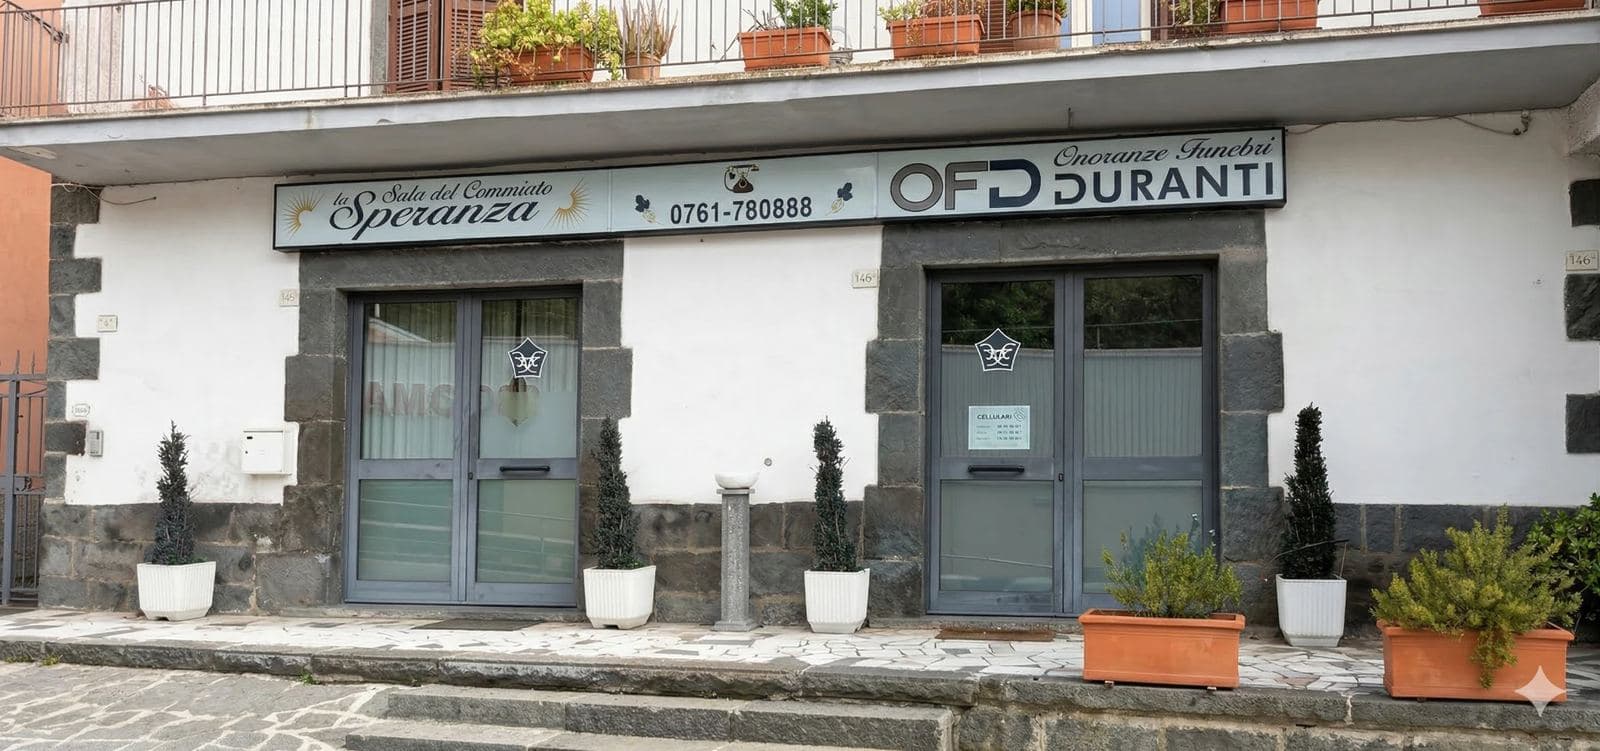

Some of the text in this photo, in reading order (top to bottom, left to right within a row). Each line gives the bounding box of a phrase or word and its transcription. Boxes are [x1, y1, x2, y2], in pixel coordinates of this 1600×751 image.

[1053, 137, 1275, 167] Onoranze Funebri
[382, 179, 553, 203] Sala del Commiato
[890, 158, 1042, 212] OFD
[1054, 162, 1273, 205] DURANTI
[329, 190, 541, 241] la Speranza
[670, 196, 813, 225] 0761-780888
[977, 413, 1013, 421] CELLULARI
